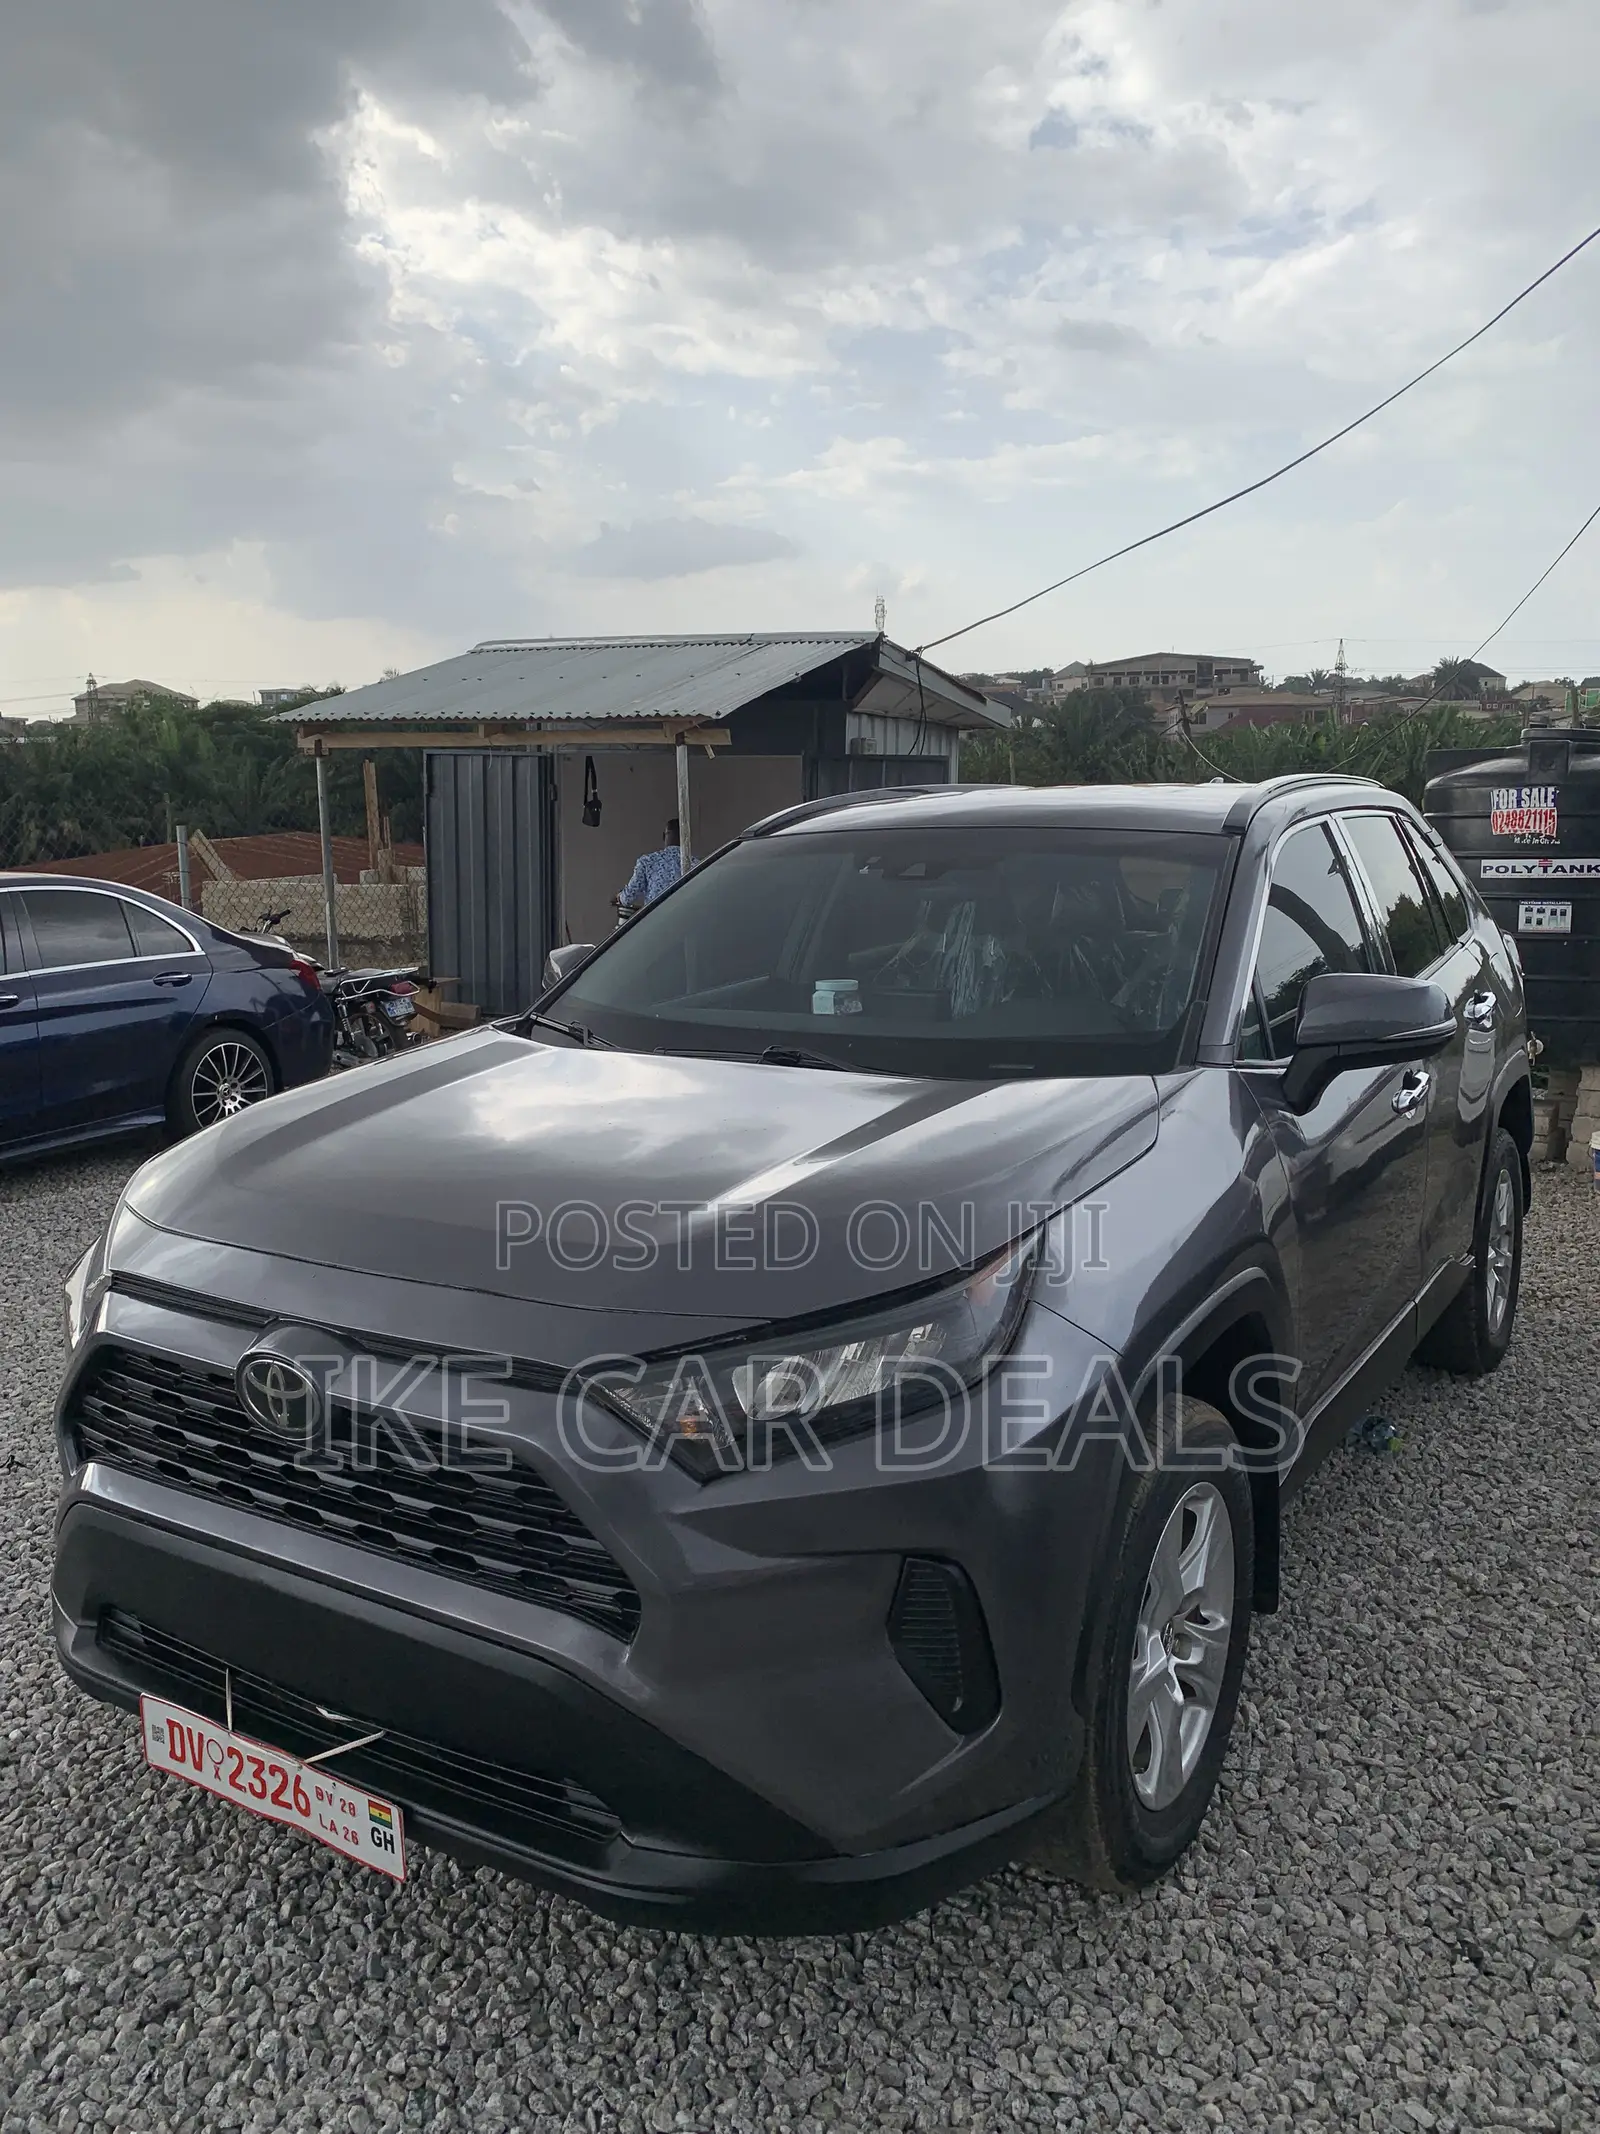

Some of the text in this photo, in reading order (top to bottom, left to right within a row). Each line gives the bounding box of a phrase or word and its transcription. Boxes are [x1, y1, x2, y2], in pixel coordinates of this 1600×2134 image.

[1493, 787, 1555, 809] FOR SALE
[1482, 860, 1600, 874] POLYTANK
[166, 1718, 311, 1818] DV 2326
[371, 1826, 395, 1855] GH
